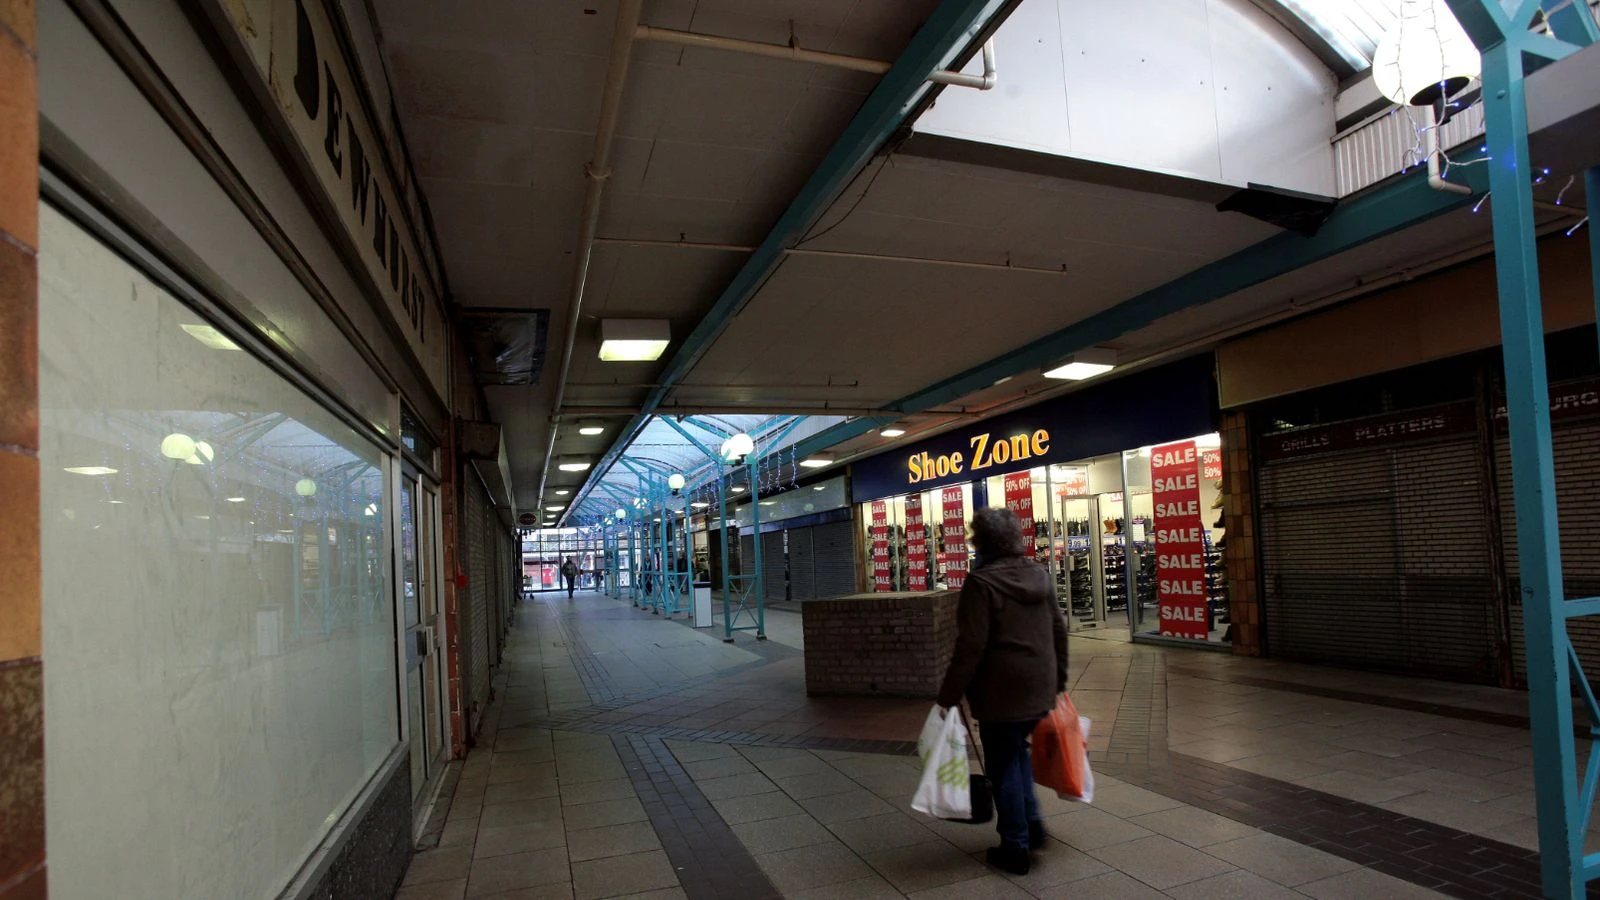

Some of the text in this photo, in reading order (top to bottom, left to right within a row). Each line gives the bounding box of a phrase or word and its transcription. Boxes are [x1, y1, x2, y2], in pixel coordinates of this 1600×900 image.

[1353, 415, 1446, 440] PLATTERS
[908, 428, 1050, 484] Shoe Zone
[1153, 448, 1196, 468] SALE
[1203, 453, 1220, 464] 50%
[1204, 467, 1221, 478] 50%
[1006, 478, 1030, 492] 50% OFF
[1154, 474, 1197, 493] SALE
[943, 492, 961, 502] SALE
[872, 504, 885, 513] SALE
[1007, 498, 1031, 511] 50% OFF
[1155, 501, 1198, 518] SALE
[944, 509, 962, 519] SALE
[873, 519, 886, 527] SALE
[1021, 519, 1032, 529] OFF
[944, 526, 963, 536] SALE
[1157, 528, 1200, 543] SALE
[874, 533, 887, 542] SALE
[1023, 536, 1032, 546] OFF
[874, 547, 888, 555] SALE
[945, 544, 964, 554] SALE
[875, 562, 888, 570] SALE
[947, 560, 965, 570] SALE
[1158, 554, 1202, 568] SALE
[876, 576, 889, 584] SALE
[1160, 580, 1203, 595] SALE
[1162, 606, 1204, 622] SALE
